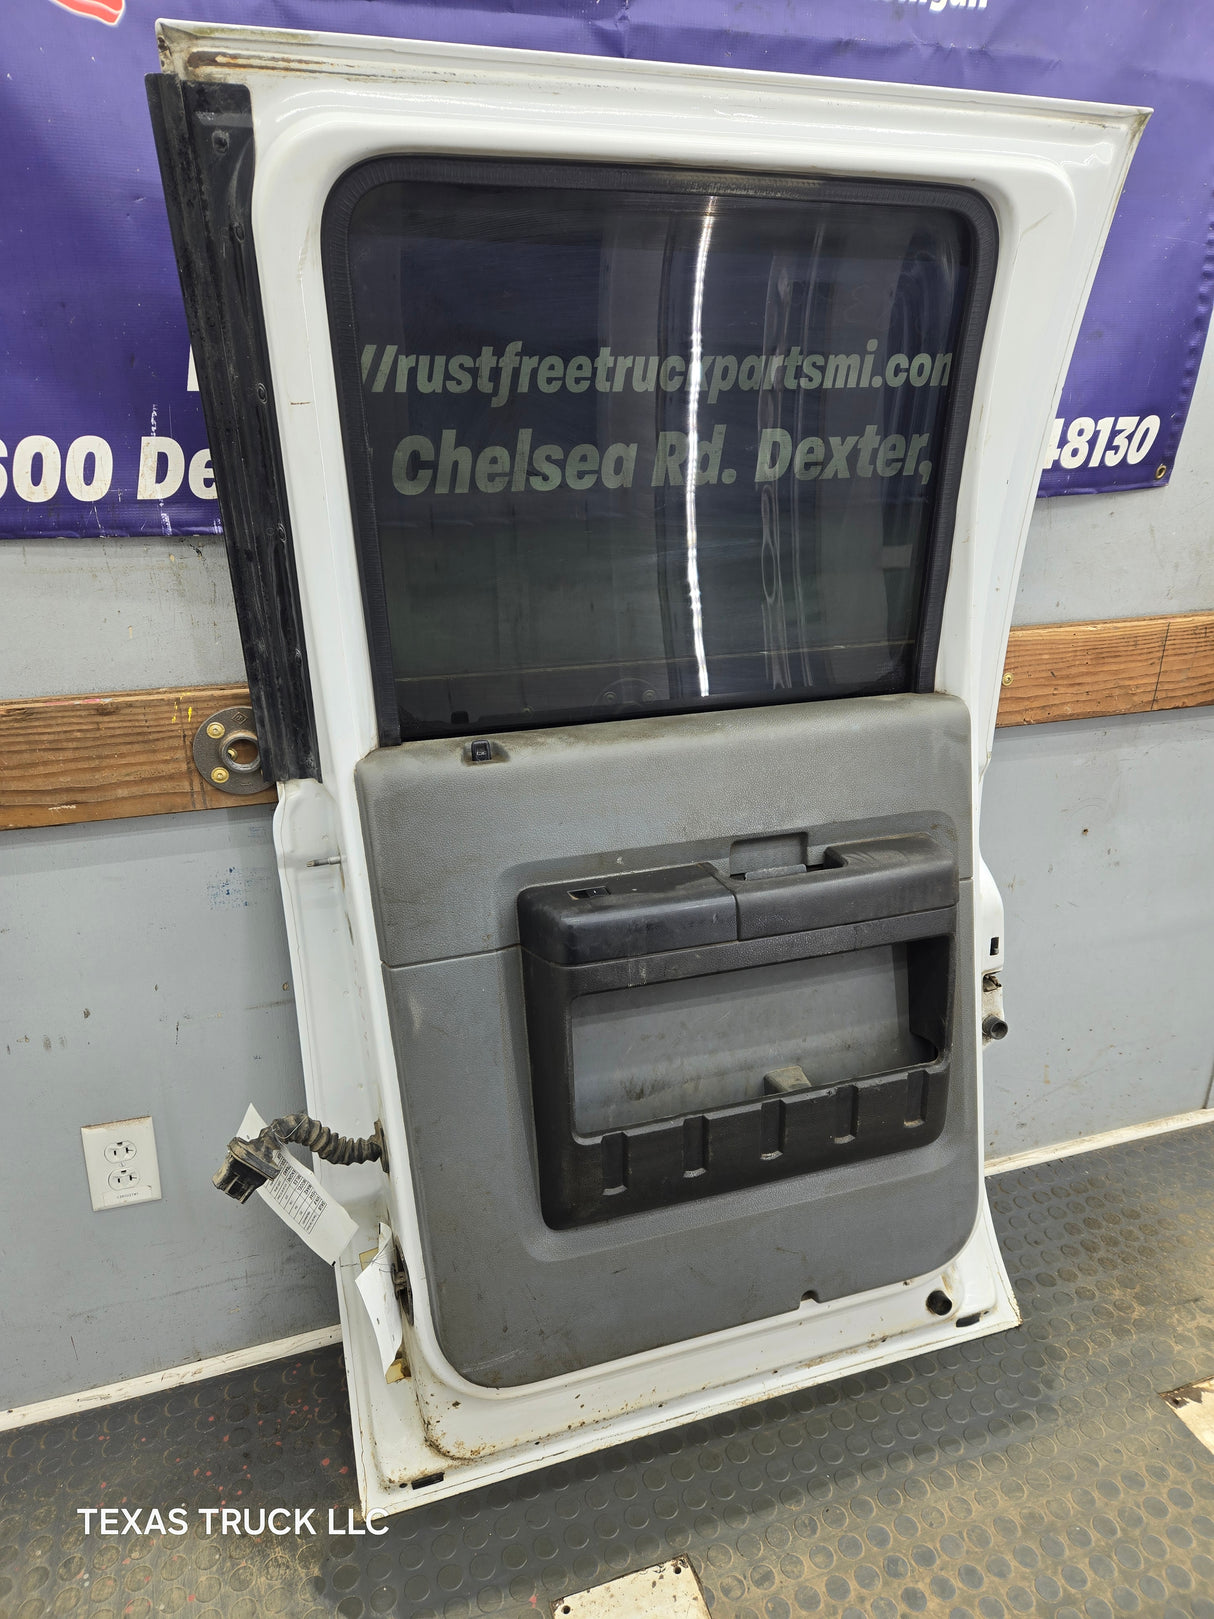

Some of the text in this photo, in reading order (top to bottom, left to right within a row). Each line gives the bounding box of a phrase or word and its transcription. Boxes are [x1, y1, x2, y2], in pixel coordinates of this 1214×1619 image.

[0, 435, 113, 502] 00
[392, 428, 638, 495] Chelsea
[651, 424, 736, 486] Rd.
[755, 425, 932, 485] Dexter,
